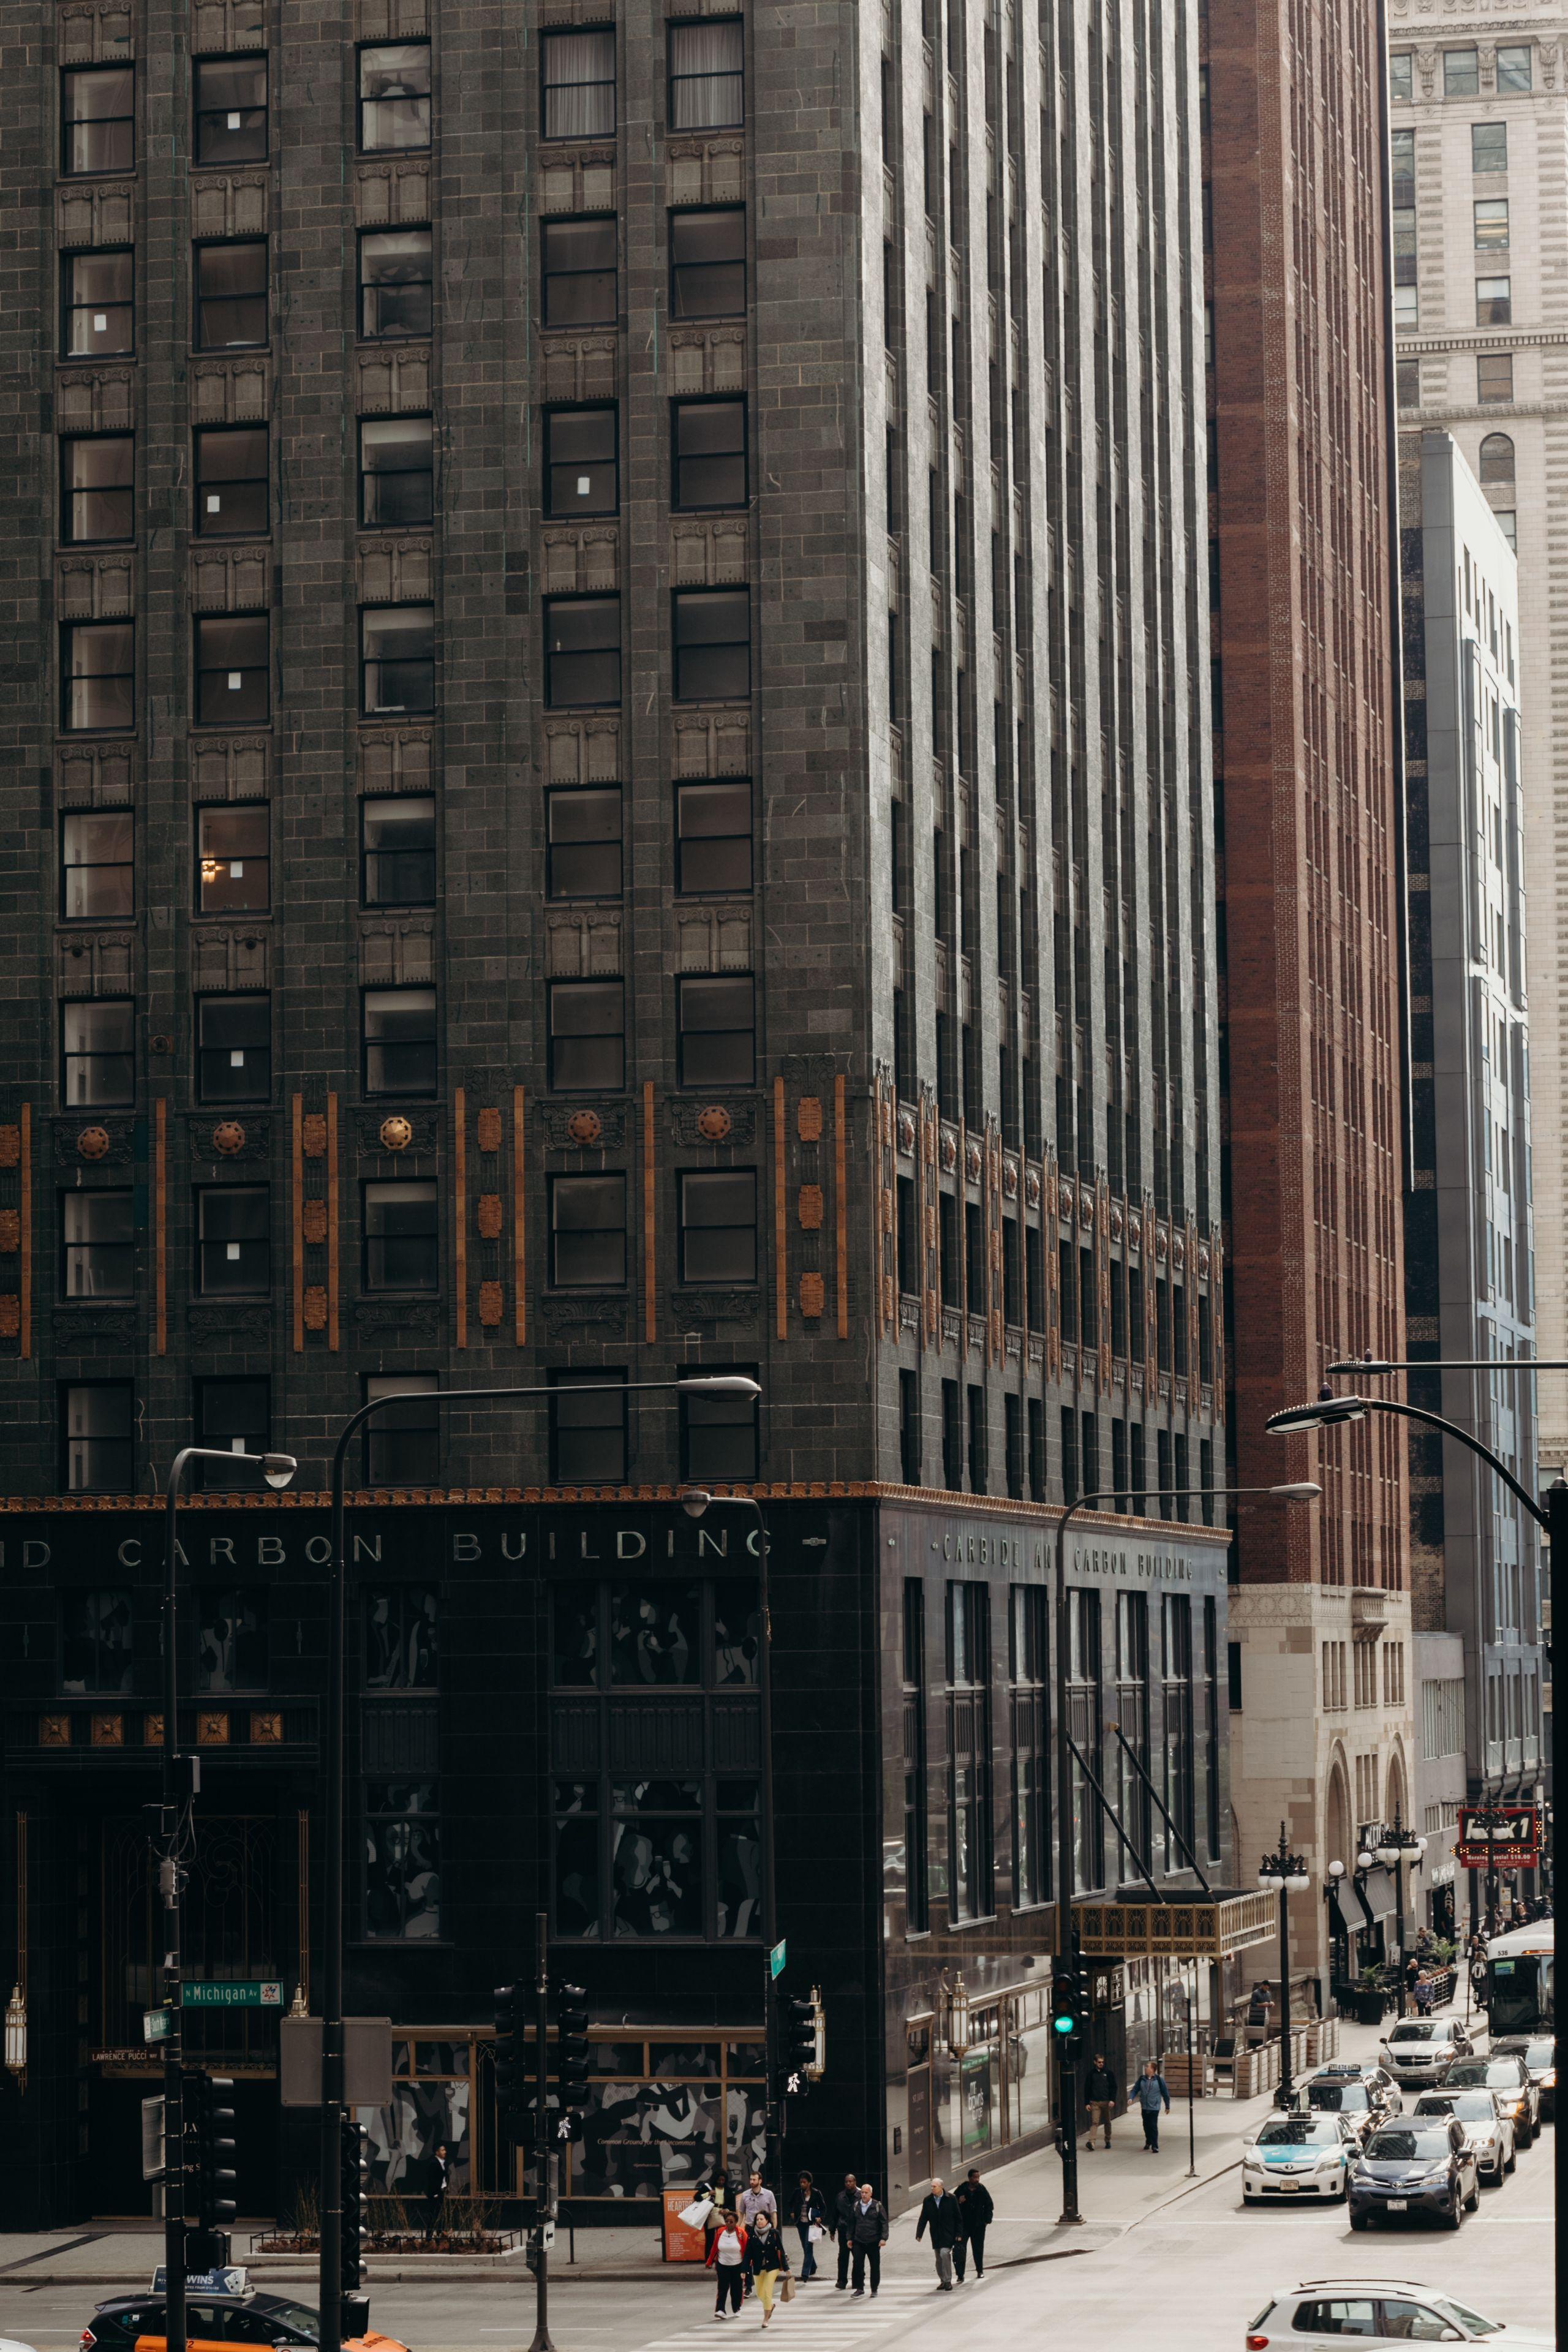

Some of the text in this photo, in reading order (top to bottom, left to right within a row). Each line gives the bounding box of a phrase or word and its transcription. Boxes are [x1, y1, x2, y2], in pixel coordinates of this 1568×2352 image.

[452, 1528, 772, 1562] BUILDING
[943, 1533, 1194, 1580] CARBIDE AN CARBON BUILDING
[1444, 1883, 1453, 1908] PAR
[193, 1986, 246, 2004] Michigan
[128, 2052, 147, 2060] PUCCI
[186, 2274, 214, 2285] WINS
